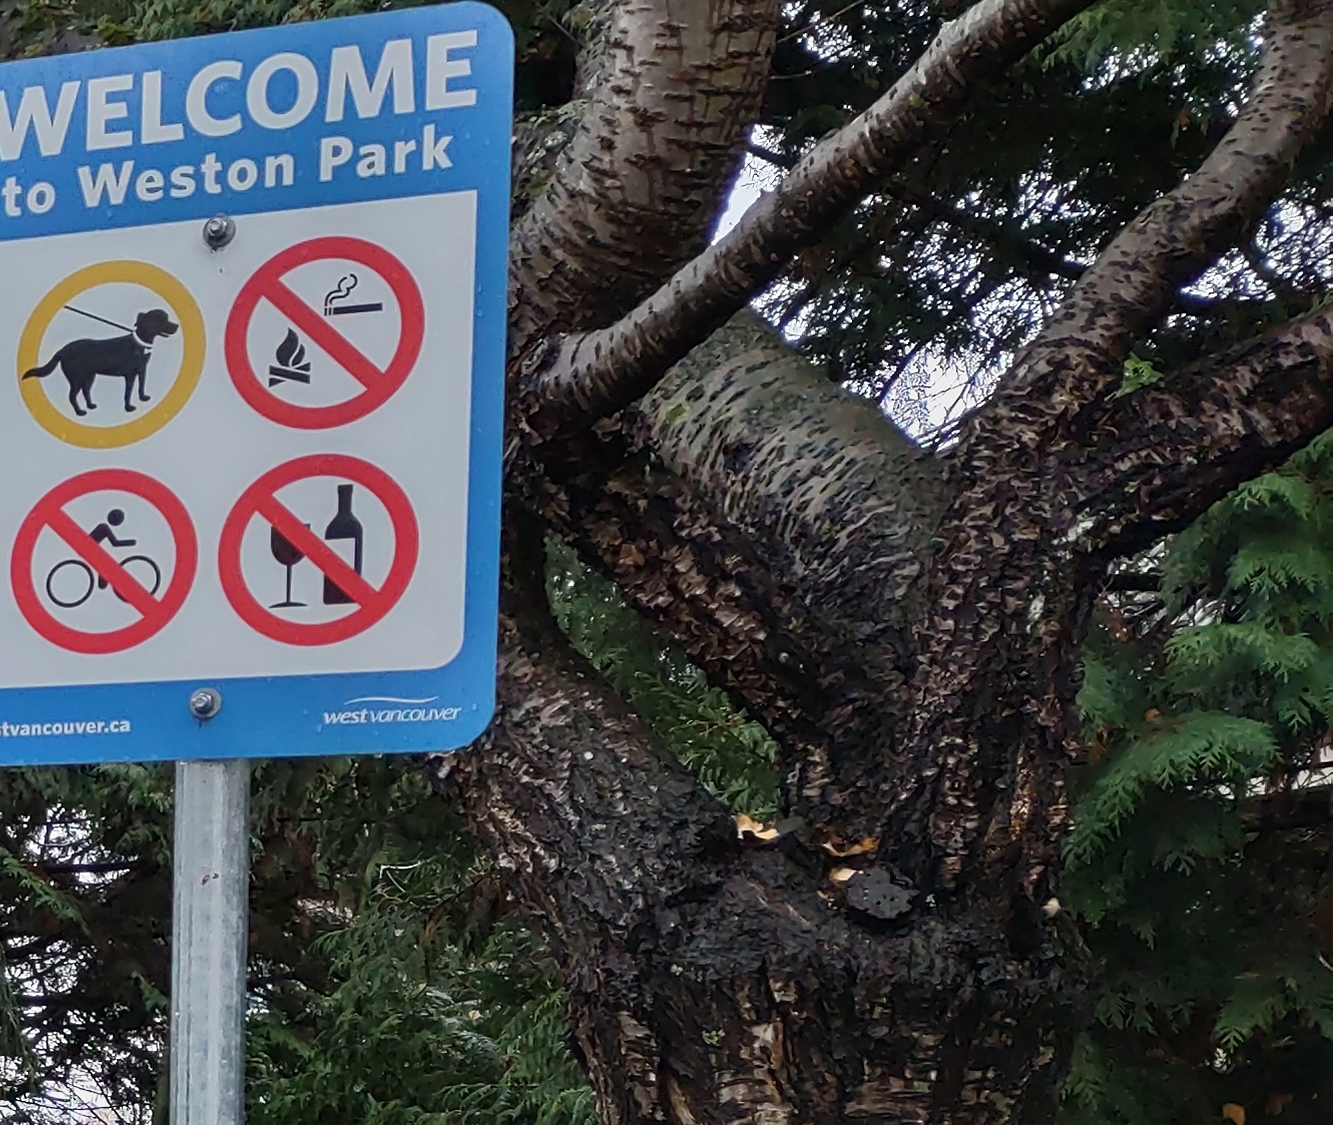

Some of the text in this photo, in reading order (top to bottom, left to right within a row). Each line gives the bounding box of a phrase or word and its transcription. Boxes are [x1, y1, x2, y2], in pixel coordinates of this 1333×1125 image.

[1, 122, 454, 218] to Weston Park
